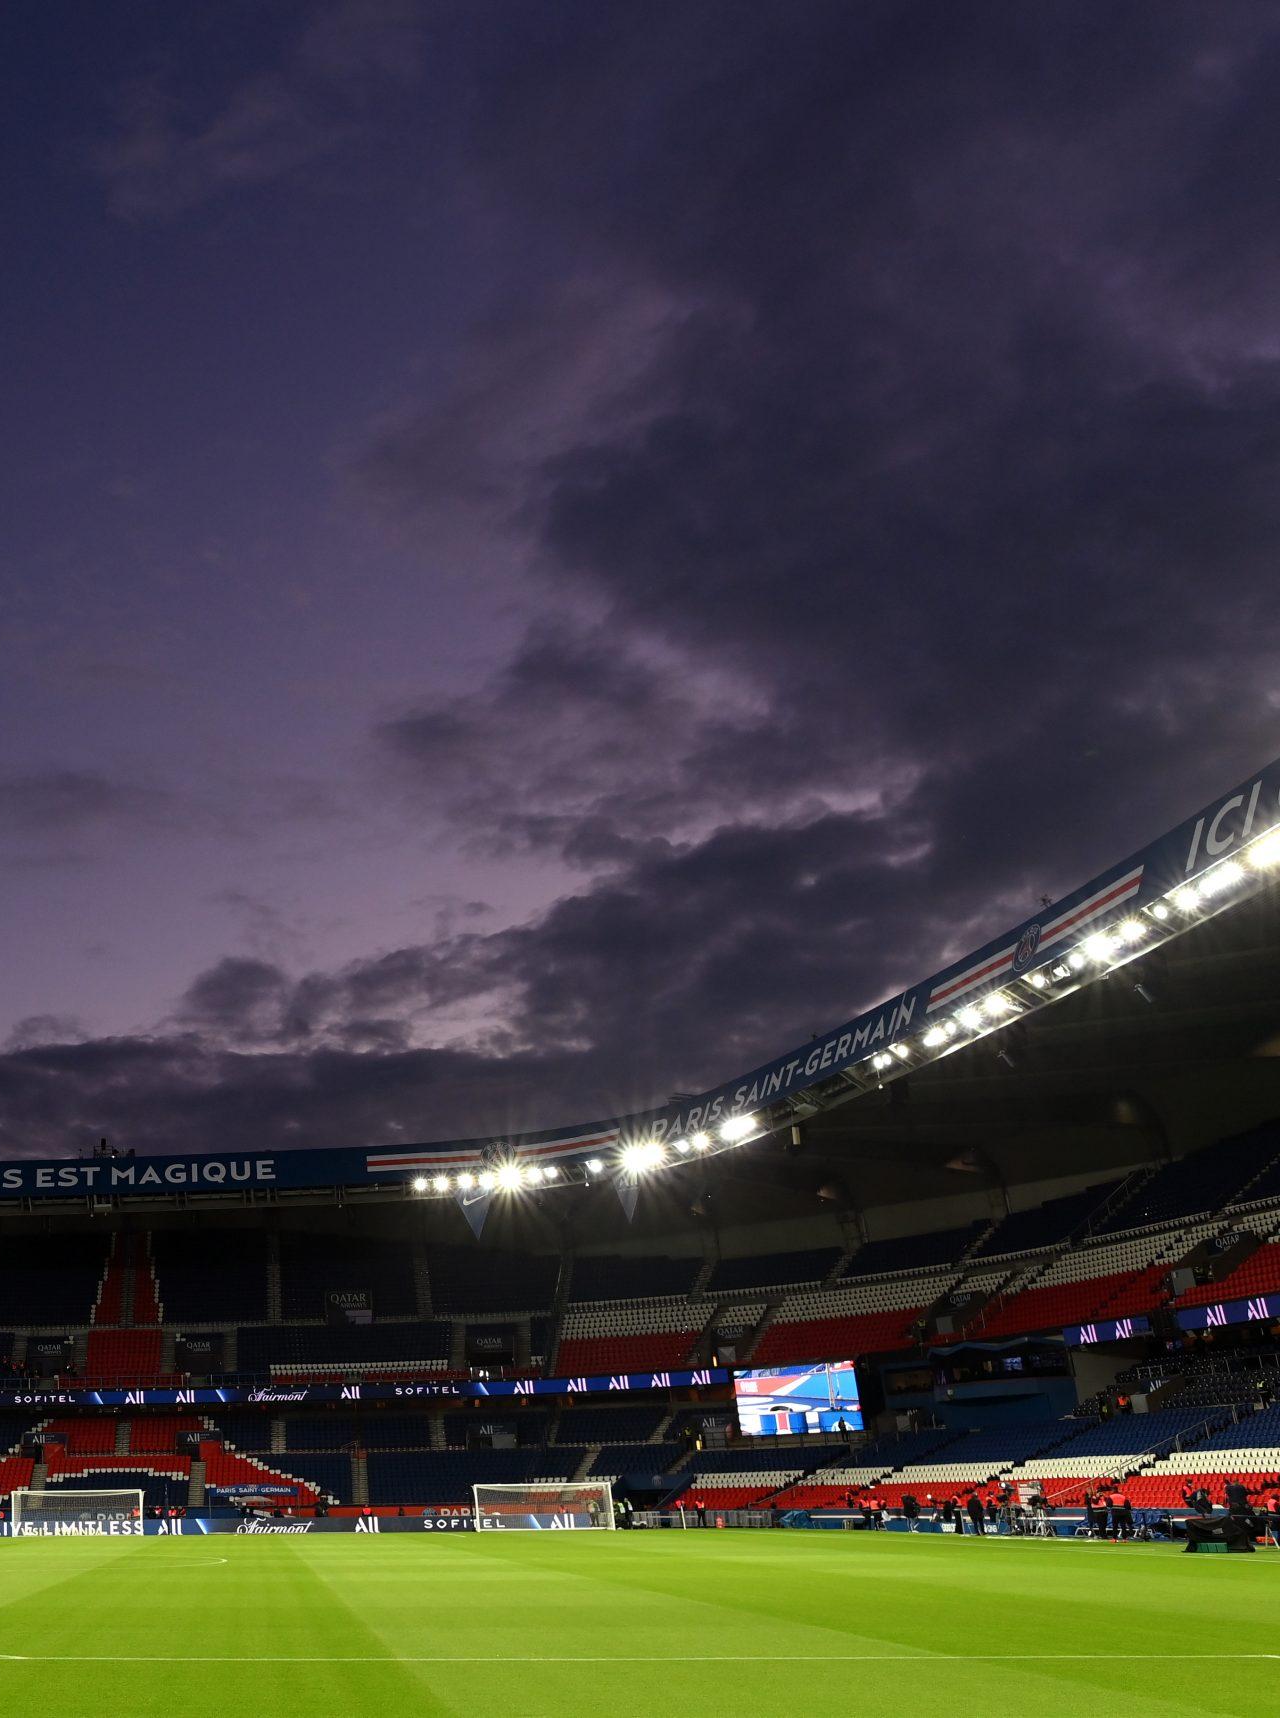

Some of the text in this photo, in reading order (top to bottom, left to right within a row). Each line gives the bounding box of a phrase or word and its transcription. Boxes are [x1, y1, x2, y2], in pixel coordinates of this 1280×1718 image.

[1186, 780, 1263, 872] ICI
[650, 996, 916, 1141] PARIS SAINT-GERMAIN
[36, 1167, 100, 1188] EST
[111, 1160, 276, 1185] MAGIQUE
[1215, 1235, 1240, 1249] QATAR
[331, 1293, 366, 1304] QATAR
[717, 1327, 745, 1337] QATAR
[186, 1342, 211, 1350] QATAR
[477, 1338, 502, 1346] QATAR
[37, 1344, 61, 1352] QATAR
[248, 1388, 309, 1402] Fairmont
[396, 1387, 459, 1395] SOFITEL
[237, 1518, 314, 1534] Fairmont
[424, 1518, 505, 1529] SOFITEL
